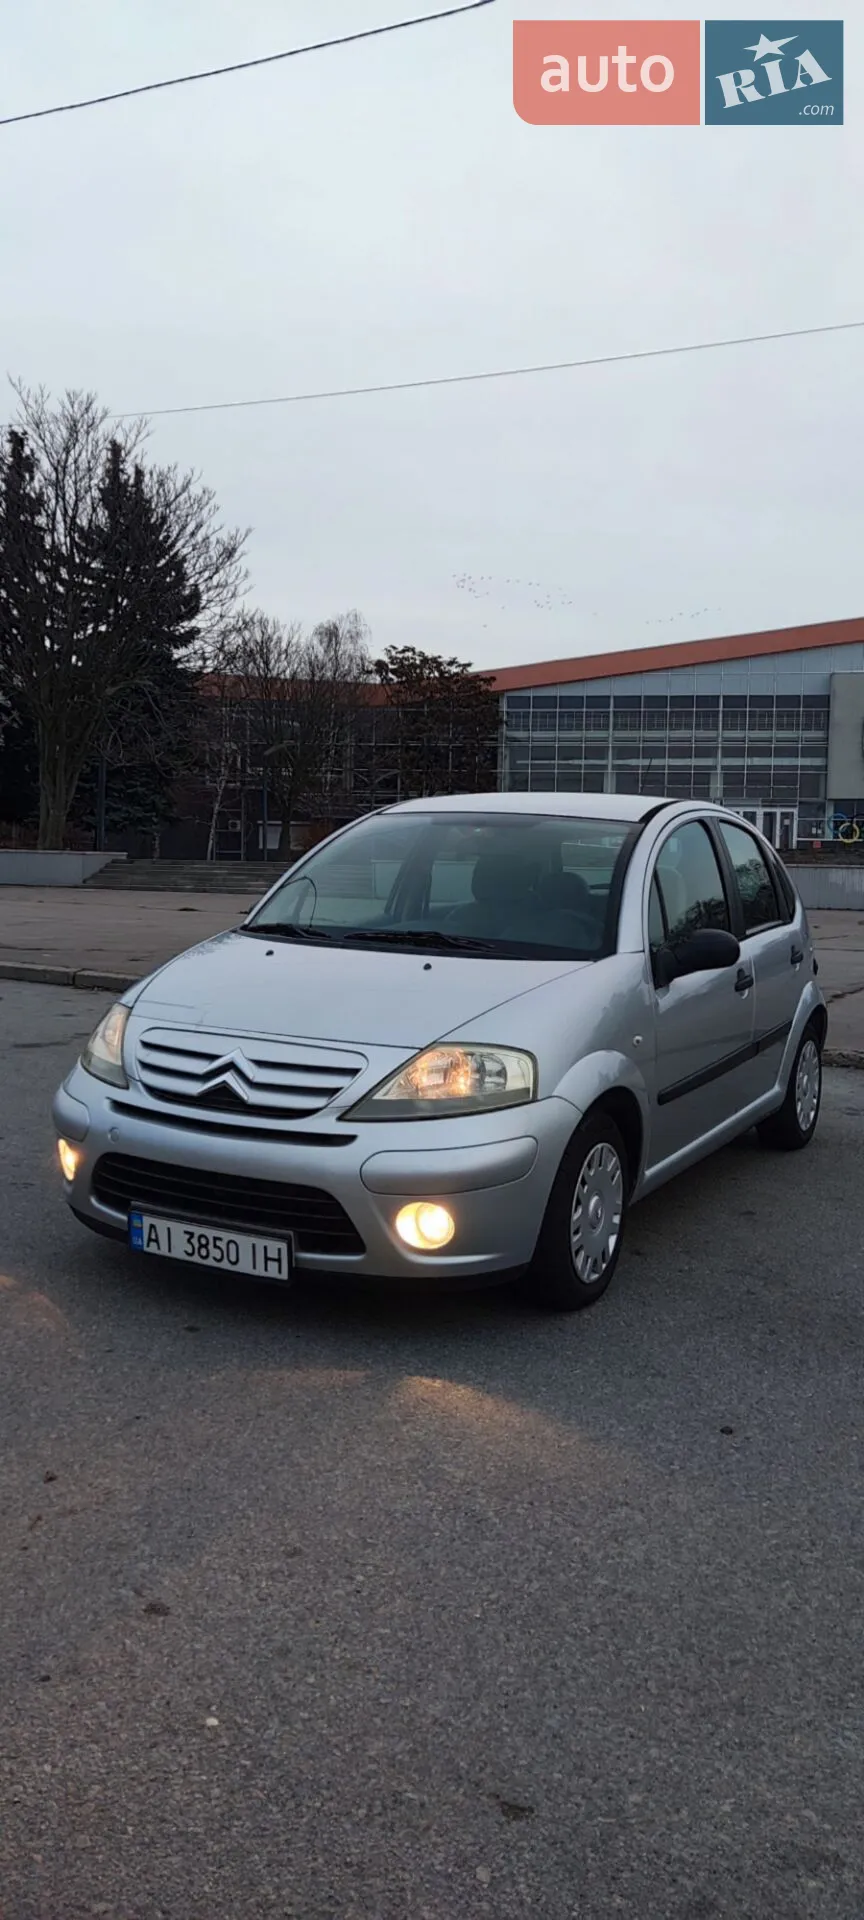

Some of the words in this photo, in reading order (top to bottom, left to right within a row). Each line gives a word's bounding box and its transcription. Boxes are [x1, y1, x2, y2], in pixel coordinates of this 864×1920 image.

[146, 1223, 172, 1253] AI
[183, 1230, 240, 1266] 3850
[251, 1243, 282, 1275] IH
